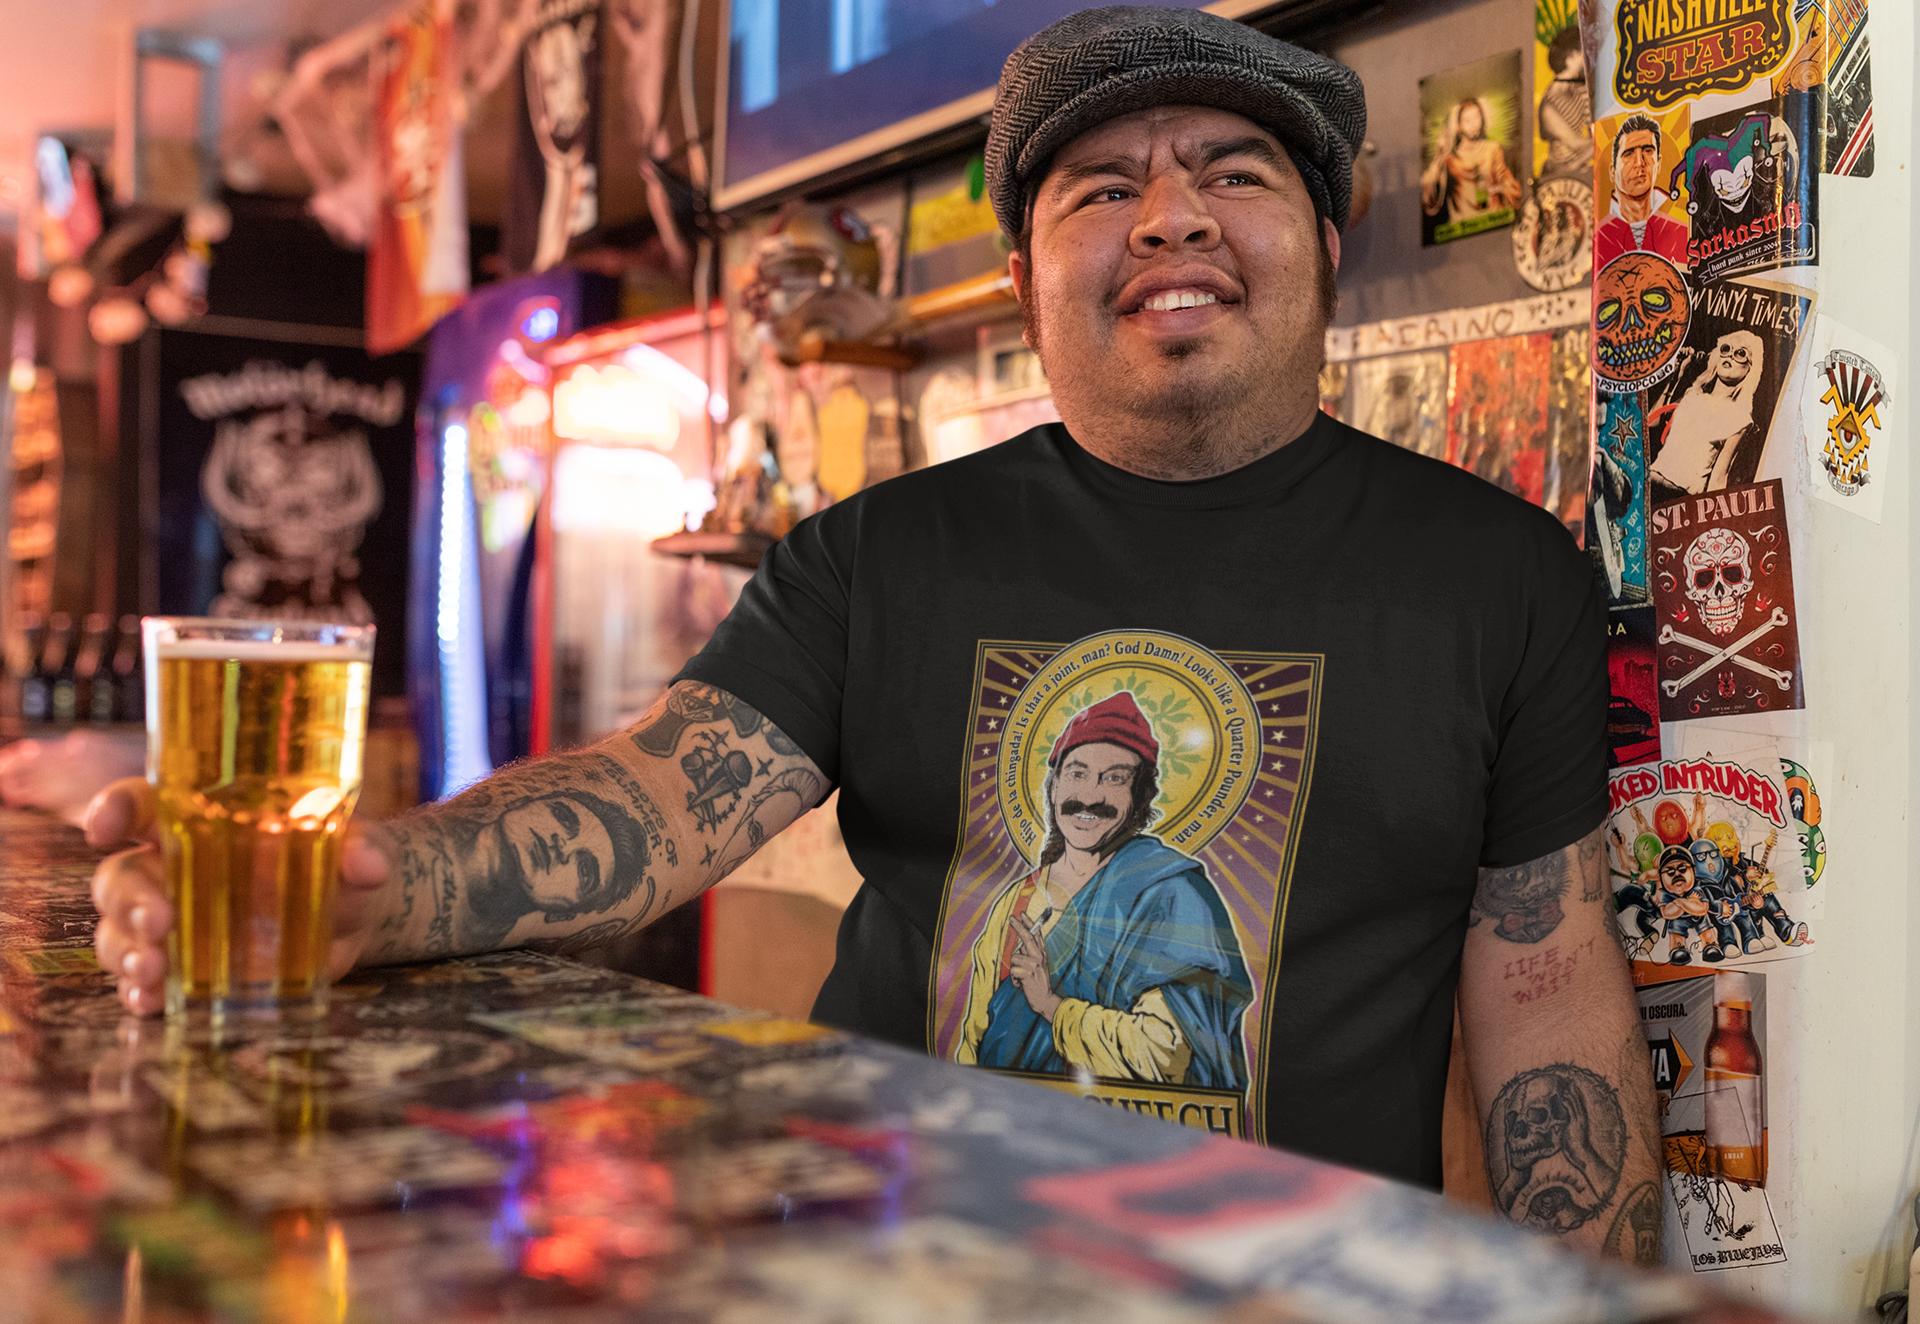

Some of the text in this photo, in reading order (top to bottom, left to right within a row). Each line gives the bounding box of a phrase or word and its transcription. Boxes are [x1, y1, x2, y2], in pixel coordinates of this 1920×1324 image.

[1638, 0, 1766, 43] NASHVI
[1636, 21, 1766, 84] STAR
[1687, 202, 1802, 270] Sarkasmo
[1711, 260, 1727, 272] hard
[1727, 252, 1744, 266] punk
[1745, 246, 1762, 258] since
[1688, 286, 1707, 311] W
[1627, 508, 1641, 527] BOY
[1652, 485, 1776, 534] ST. PAULI
[1005, 640, 1246, 847] Hijo de la chingada! Is that a joint, man? God Damn! Looks like a Quarter Pounder, man.
[1662, 761, 1782, 824] INTRUDER
[629, 780, 667, 830] BOYS
[665, 838, 679, 868] OF
[1648, 1002, 1688, 1020] OSCURA.
[1724, 1152, 1744, 1160] AMBAR
[1690, 1243, 1784, 1266] LOS BLUEJAYS
